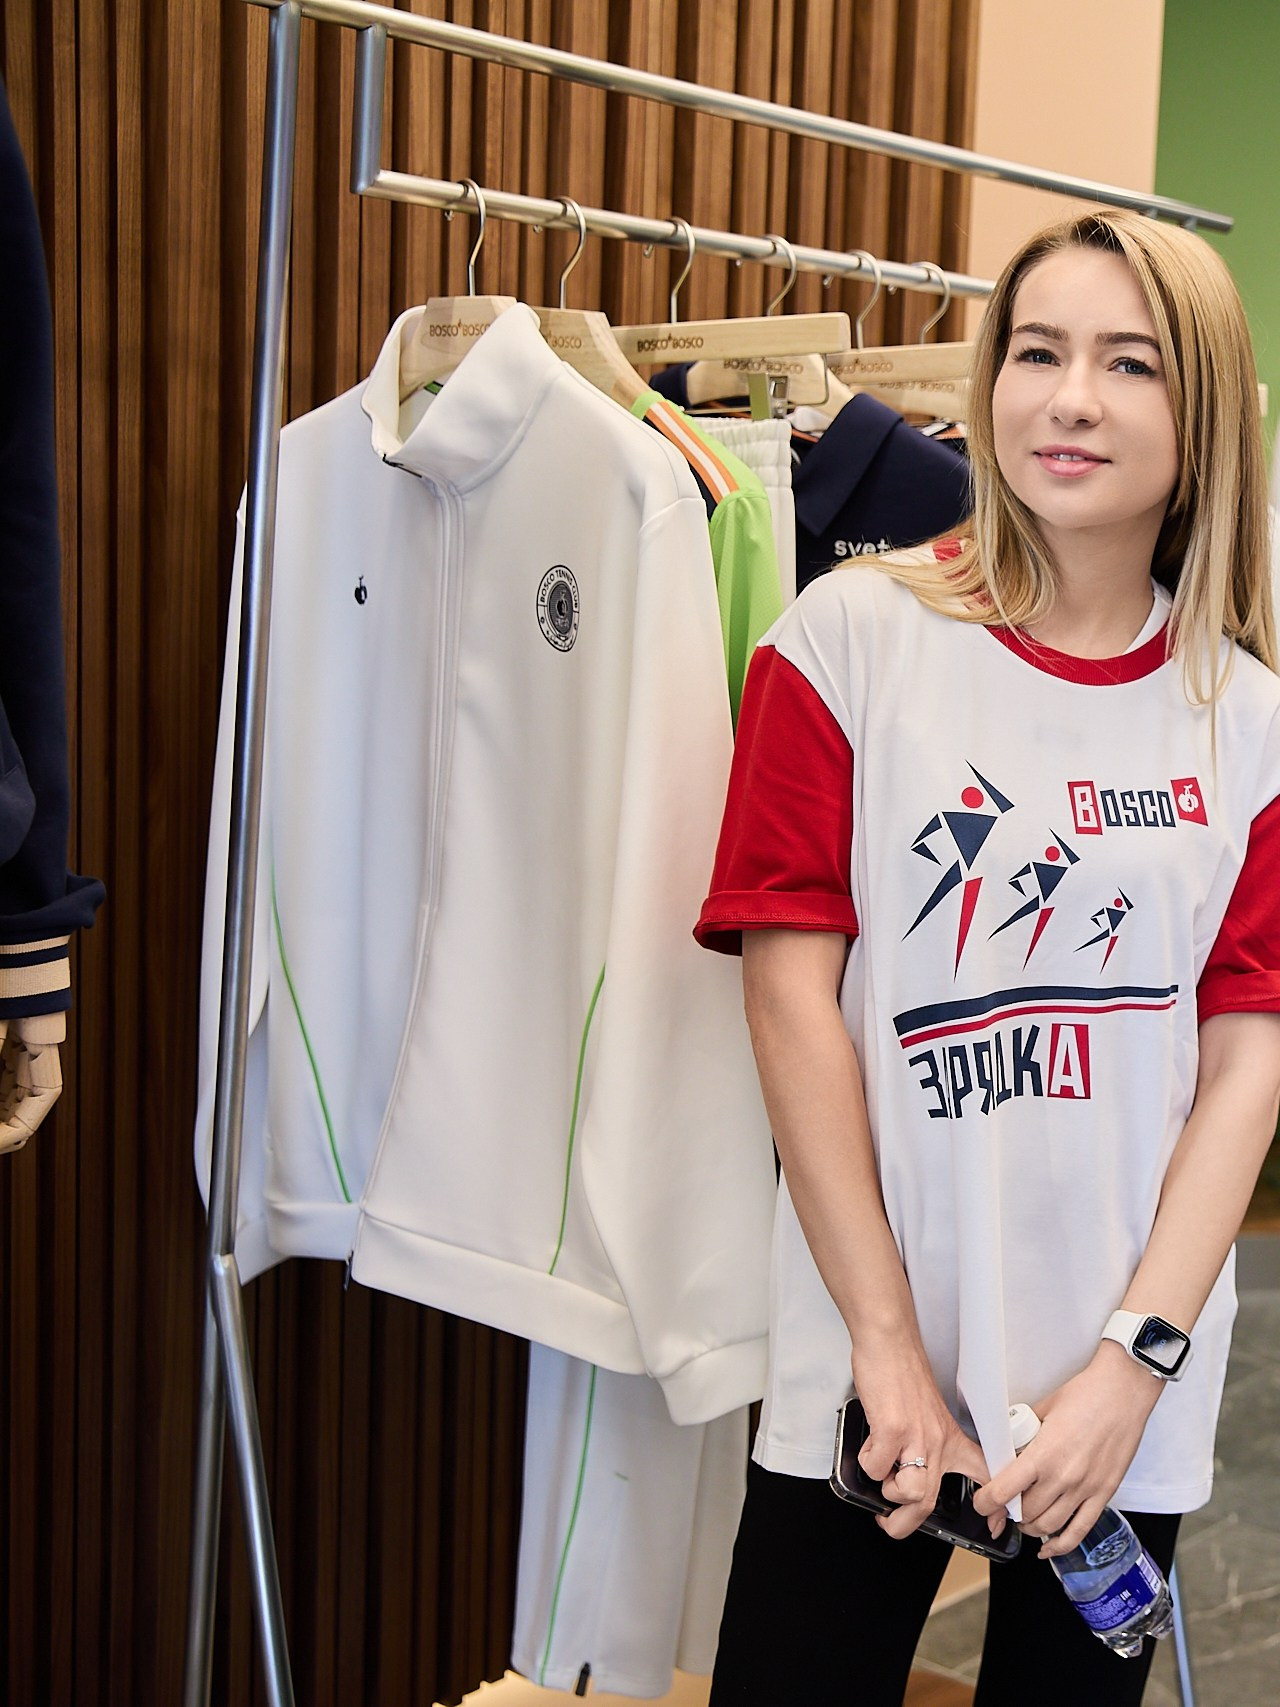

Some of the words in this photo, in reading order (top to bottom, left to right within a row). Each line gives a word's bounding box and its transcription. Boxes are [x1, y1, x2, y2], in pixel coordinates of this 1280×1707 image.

[429, 324, 459, 337] BOSCO
[551, 335, 582, 349] BOSCO
[637, 338, 668, 352] BOSCO
[672, 337, 704, 350] BOSCO
[723, 358, 761, 371] BOSCO
[540, 573, 555, 603] BOSCO
[555, 569, 573, 586] TENNIS
